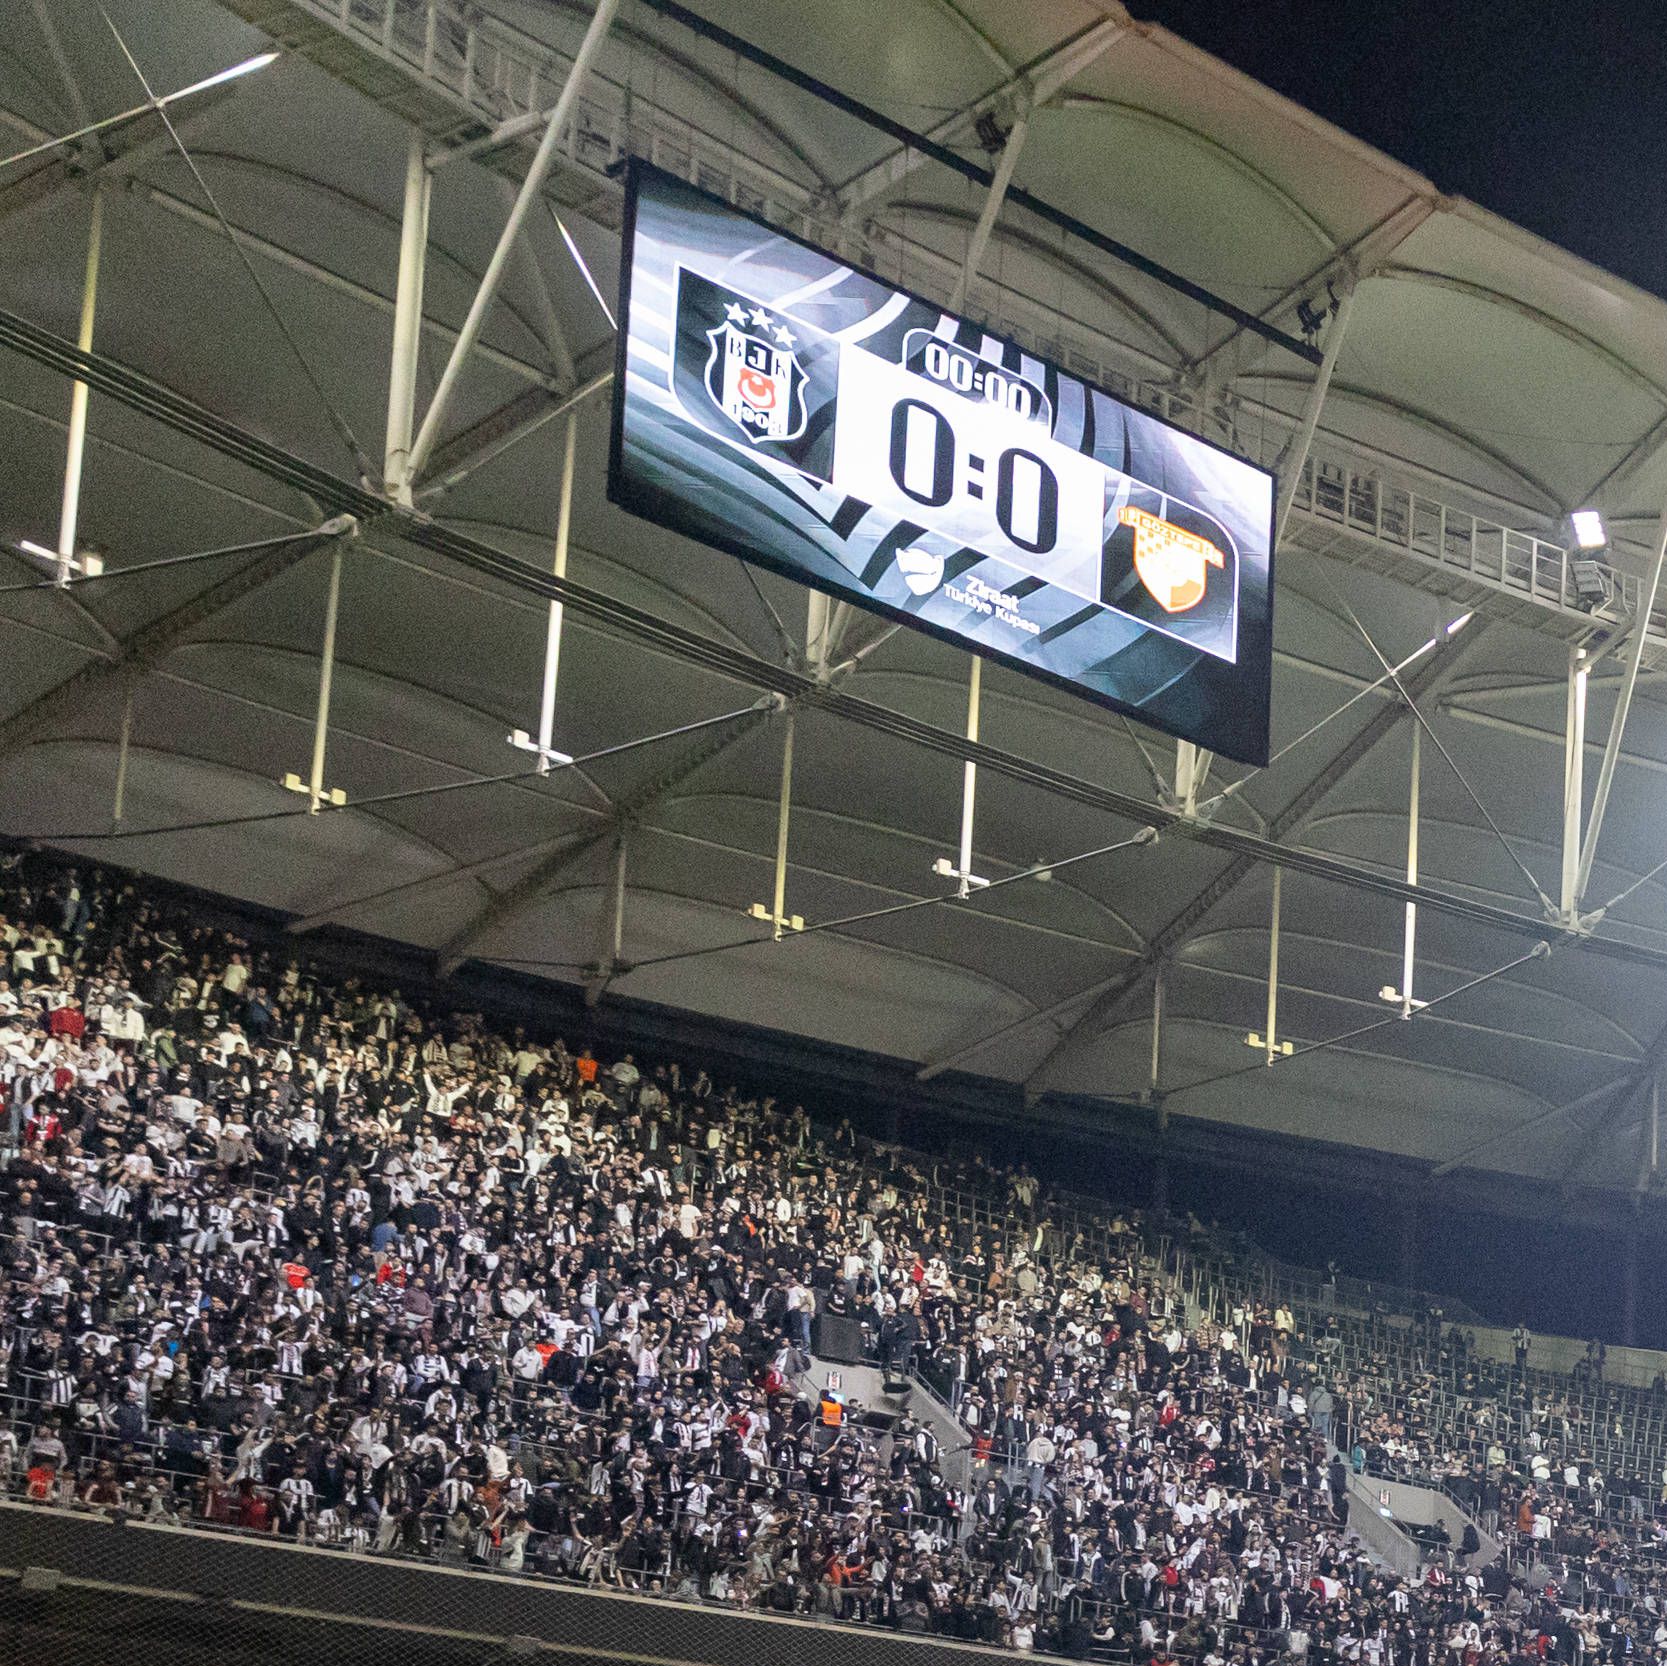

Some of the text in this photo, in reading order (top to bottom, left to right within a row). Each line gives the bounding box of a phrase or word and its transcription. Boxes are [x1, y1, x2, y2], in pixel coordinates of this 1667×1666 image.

[925, 342, 1032, 420] 00:00
[889, 397, 1059, 554] 0:0
[965, 574, 1020, 613] Ziraat
